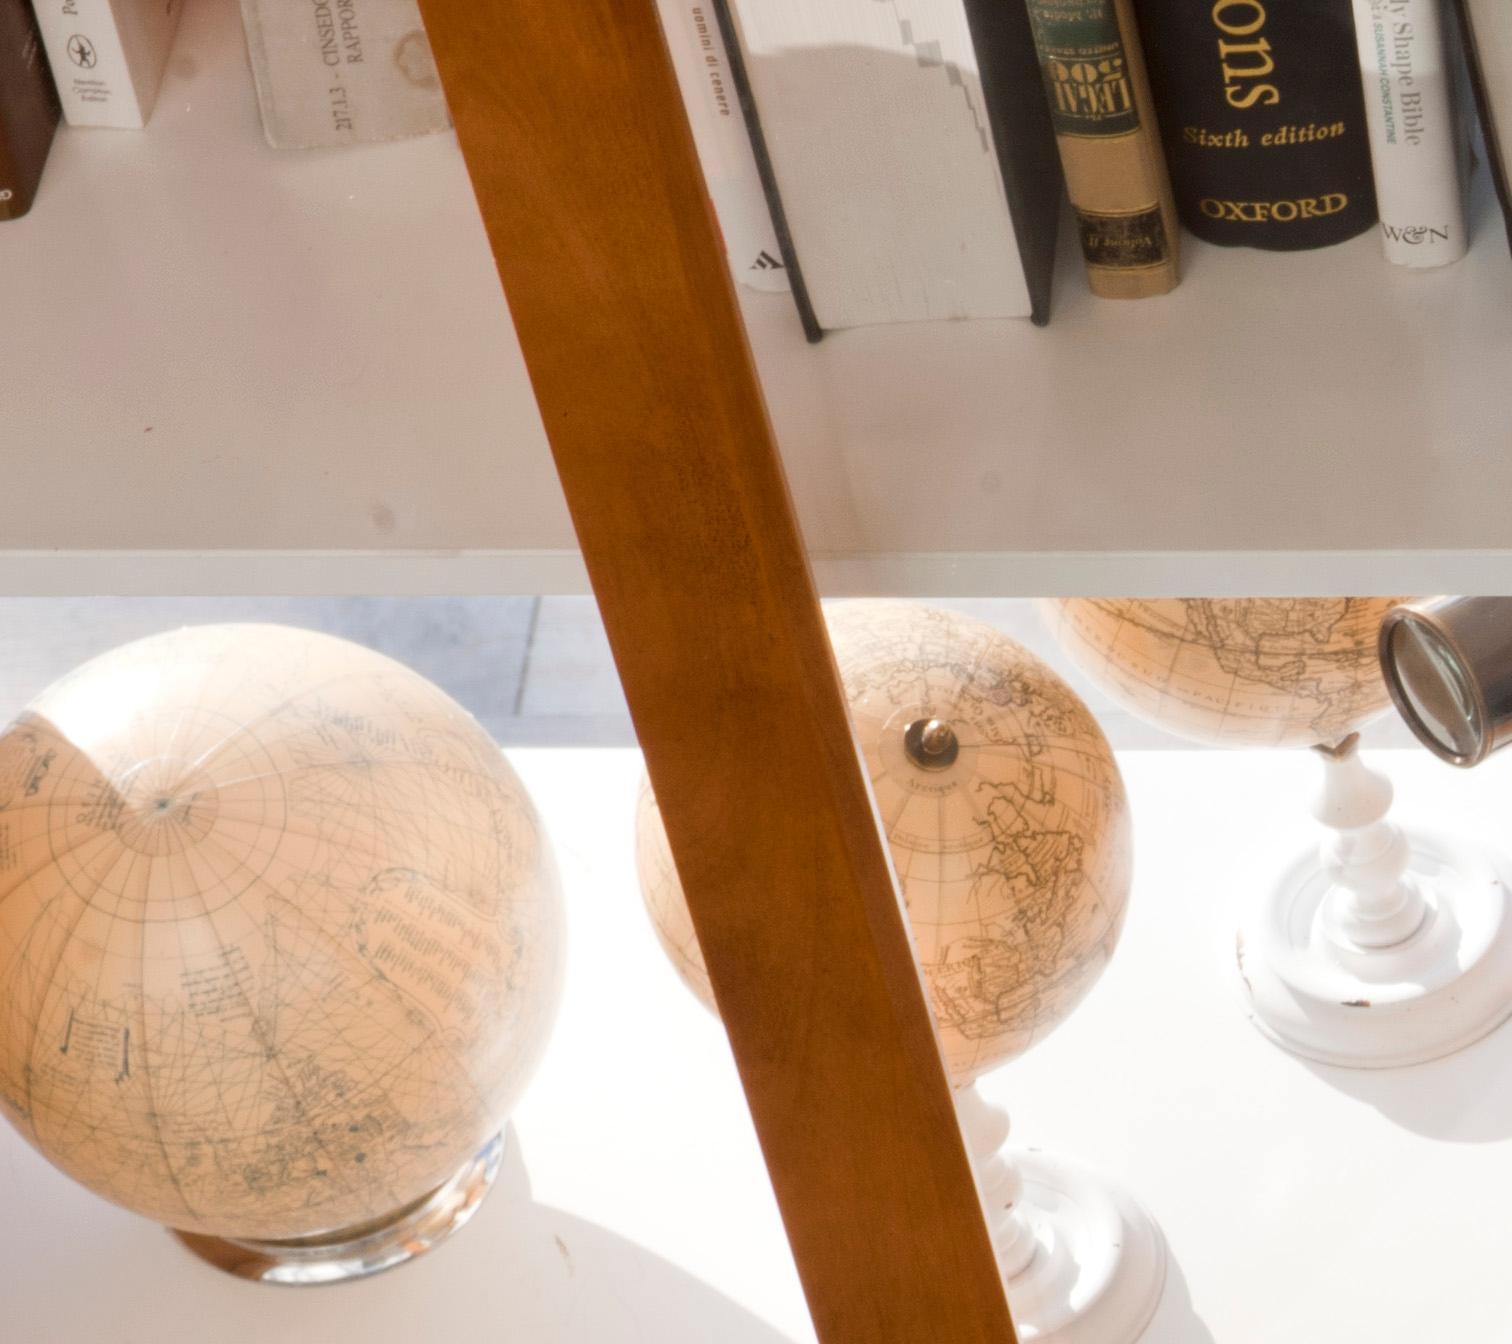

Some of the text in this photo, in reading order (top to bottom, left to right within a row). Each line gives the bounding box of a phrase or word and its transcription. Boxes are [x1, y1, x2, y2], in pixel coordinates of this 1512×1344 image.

[692, 6, 730, 117] uomini di cenere
[1372, 22, 1391, 83] SUSANNAH
[1377, 82, 1398, 146] CONSTANTINE
[1391, 20, 1426, 148] Shape Bible
[1183, 120, 1346, 148] Sixth edition
[1201, 192, 1349, 222] OXFORD
[1381, 222, 1451, 244] W&N
